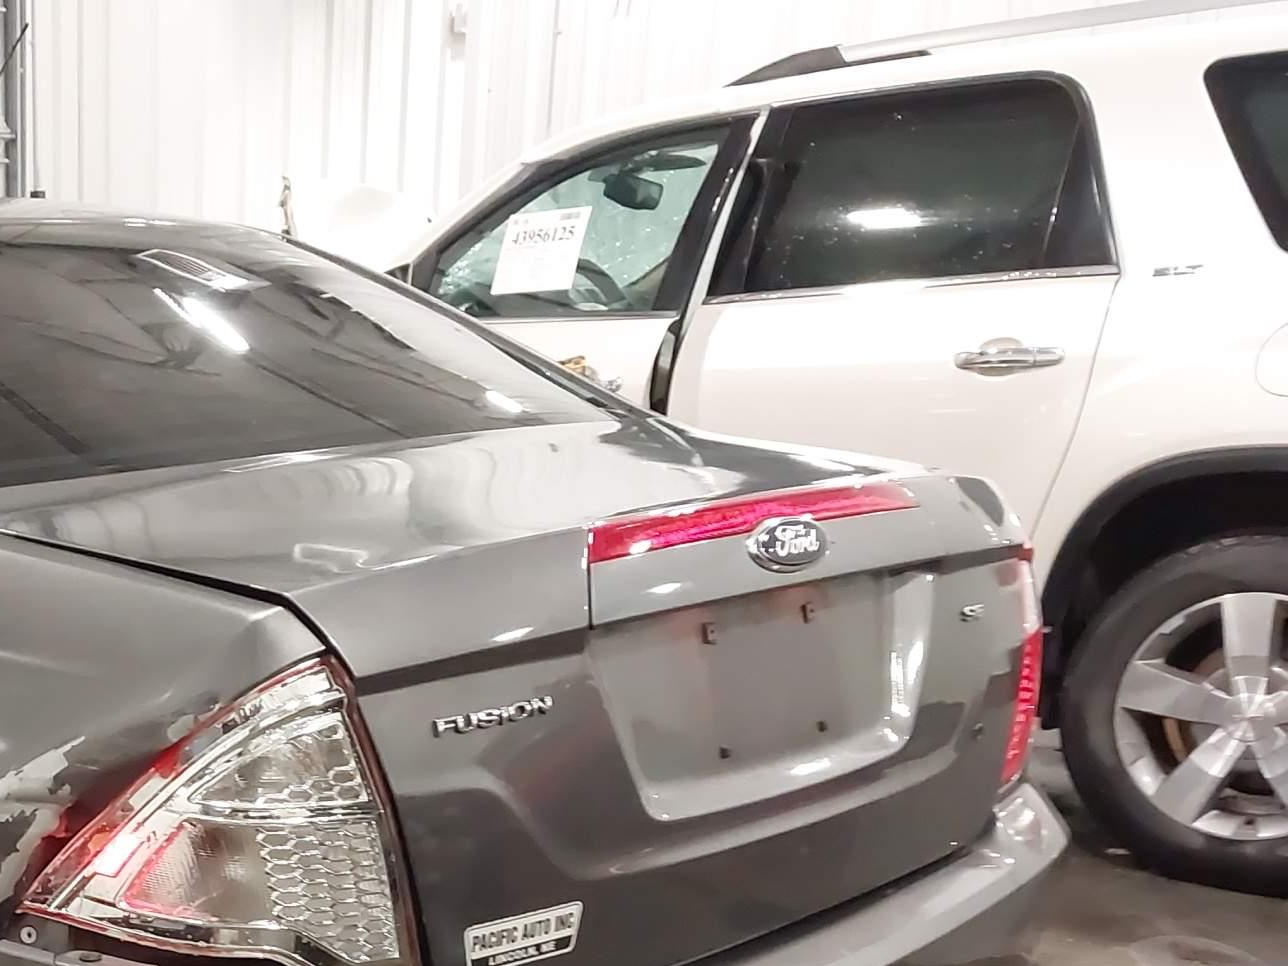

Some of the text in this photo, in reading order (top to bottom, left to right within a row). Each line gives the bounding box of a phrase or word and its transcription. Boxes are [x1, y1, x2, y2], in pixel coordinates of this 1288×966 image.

[512, 225, 576, 246] 43956125
[775, 524, 821, 557] Ford
[432, 696, 553, 738] FUSION
[472, 912, 575, 953] PACIFIC AUTO INC
